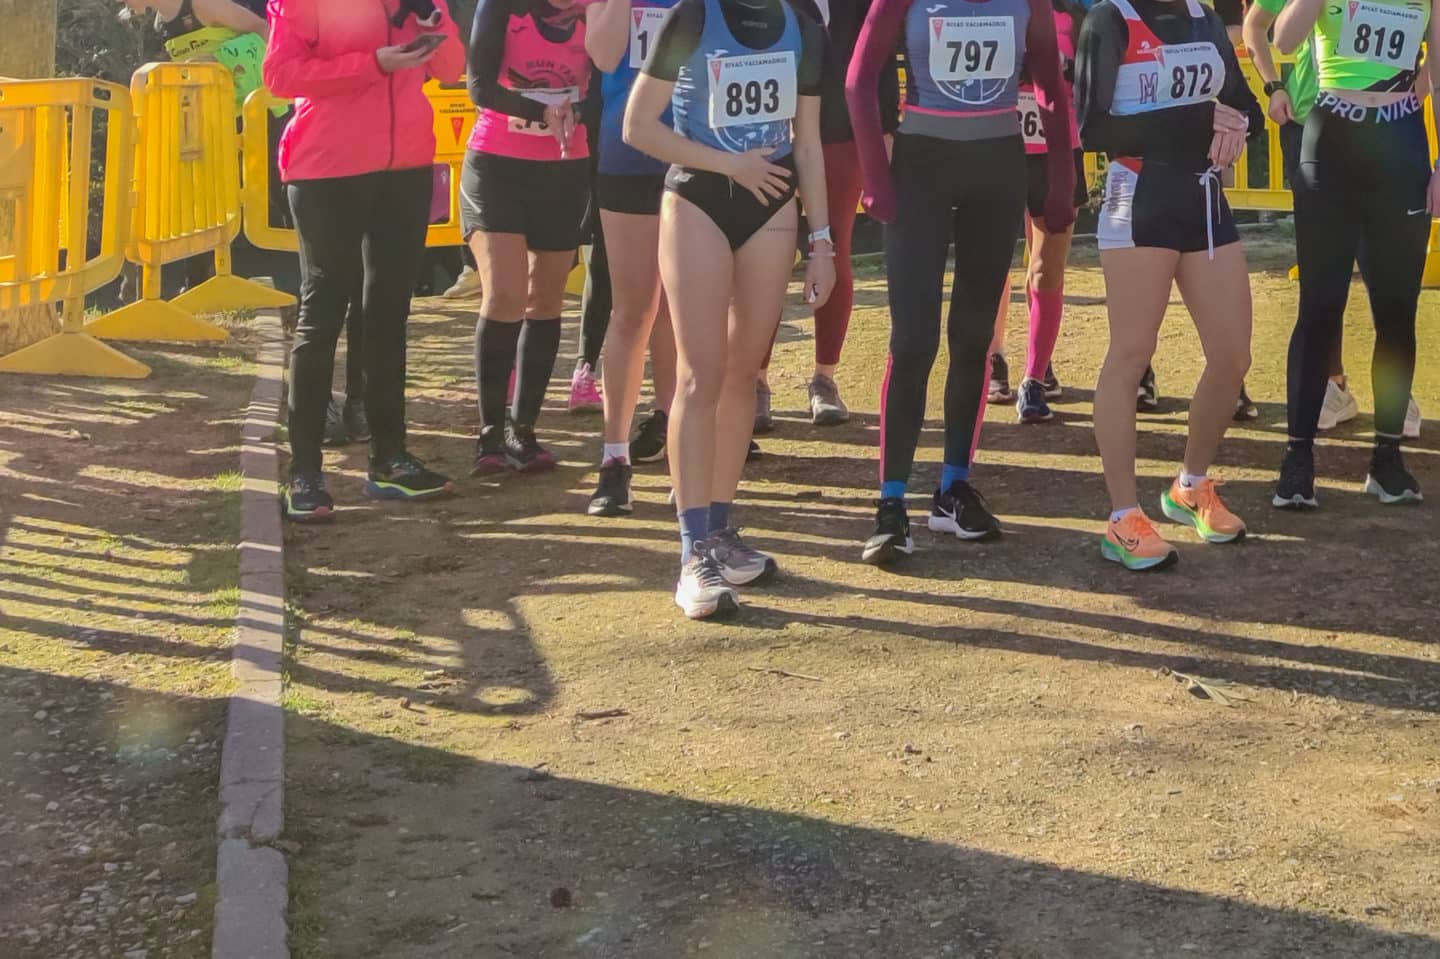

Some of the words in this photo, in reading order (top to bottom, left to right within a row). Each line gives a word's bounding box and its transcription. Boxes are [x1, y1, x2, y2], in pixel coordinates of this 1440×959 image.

[946, 40, 998, 73] 797
[1353, 23, 1405, 60] 819
[726, 79, 779, 117] 893
[1170, 63, 1213, 99] 872
[1320, 93, 1368, 123] PRO
[1375, 92, 1420, 124] NIKE
